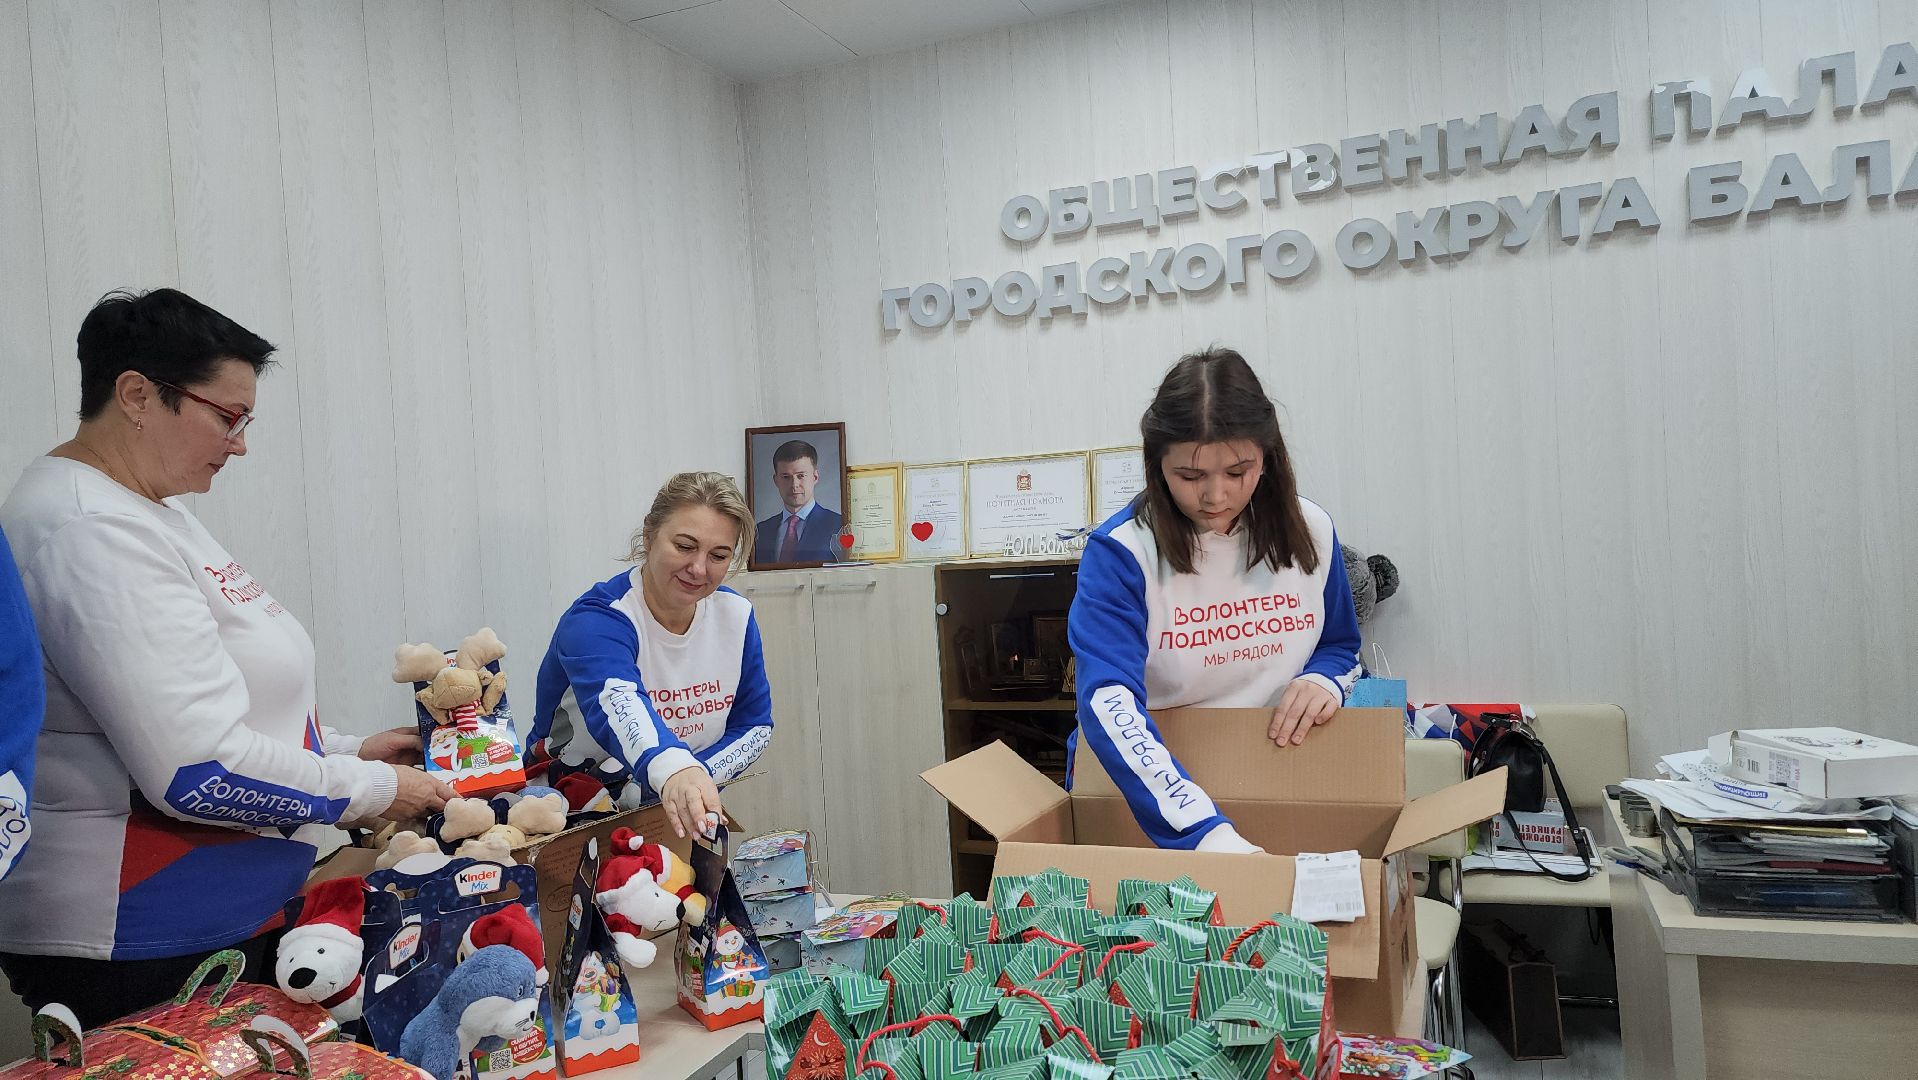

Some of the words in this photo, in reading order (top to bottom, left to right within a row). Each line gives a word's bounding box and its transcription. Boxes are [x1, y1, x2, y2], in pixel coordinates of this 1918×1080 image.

[1000, 90, 1620, 243] ОБЩЕСТВЕННАЯ
[882, 229, 1316, 334] ГОРОДСКОГО
[1335, 176, 1661, 270] ОКРУГА
[1174, 592, 1301, 626] ВОЛОНТЕРЫ
[1158, 613, 1315, 650] ПОДМОСКОВЬЯ
[1204, 651, 1229, 667] МЫ
[1233, 643, 1283, 662] РЯДОМ
[647, 680, 720, 703] ЛОНТЕРЫ
[1103, 693, 1160, 768] РЯДОМ
[199, 775, 312, 818] ВОЛОНТЕРЫ
[1154, 769, 1196, 810] МЫ
[471, 880, 489, 892] Mix
